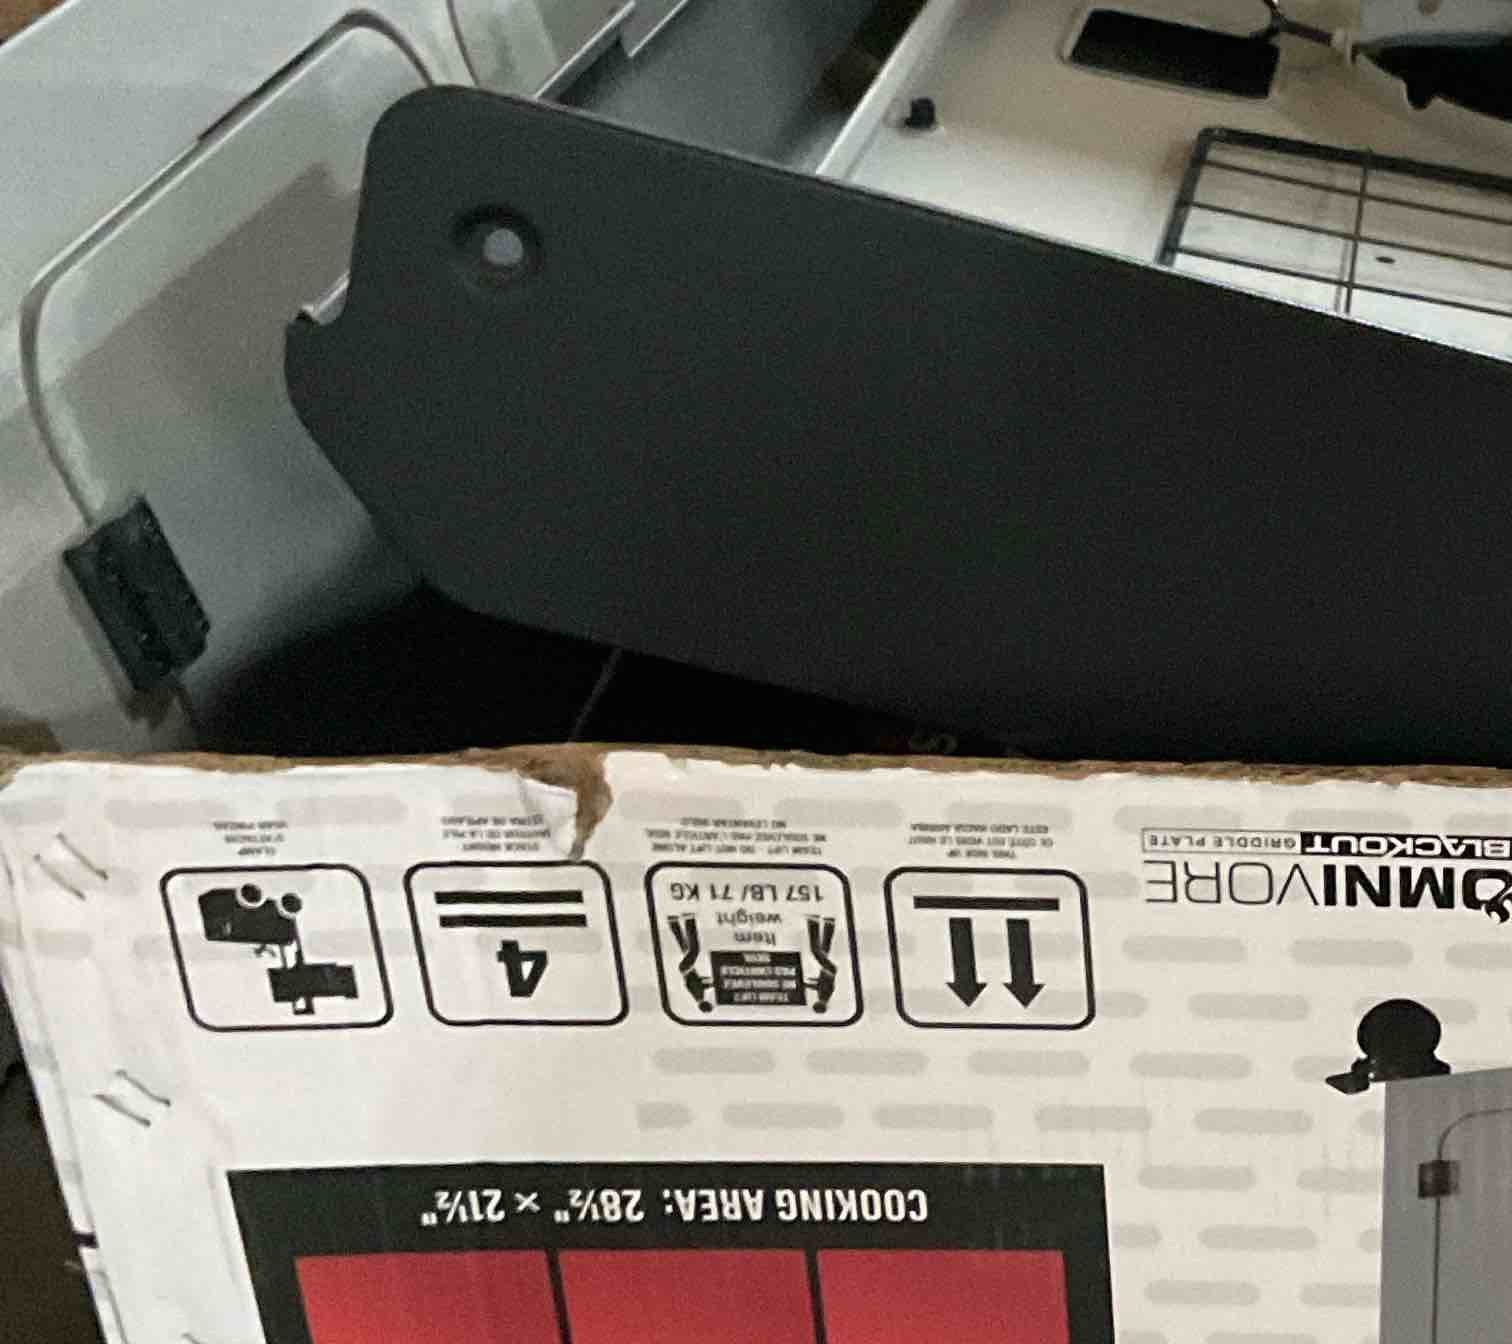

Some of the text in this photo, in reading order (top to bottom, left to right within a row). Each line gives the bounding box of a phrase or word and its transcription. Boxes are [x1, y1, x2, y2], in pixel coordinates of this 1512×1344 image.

[1149, 834, 1512, 860] BLACKOUT GRIDDLE PLATE
[670, 883, 699, 901] KG
[710, 885, 733, 901] 71
[786, 885, 823, 902] 157
[716, 908, 782, 926] weight
[733, 931, 776, 946] Item
[497, 940, 548, 998] 4
[663, 1187, 765, 1223] AREA:
[775, 1187, 928, 1223] COOKING
